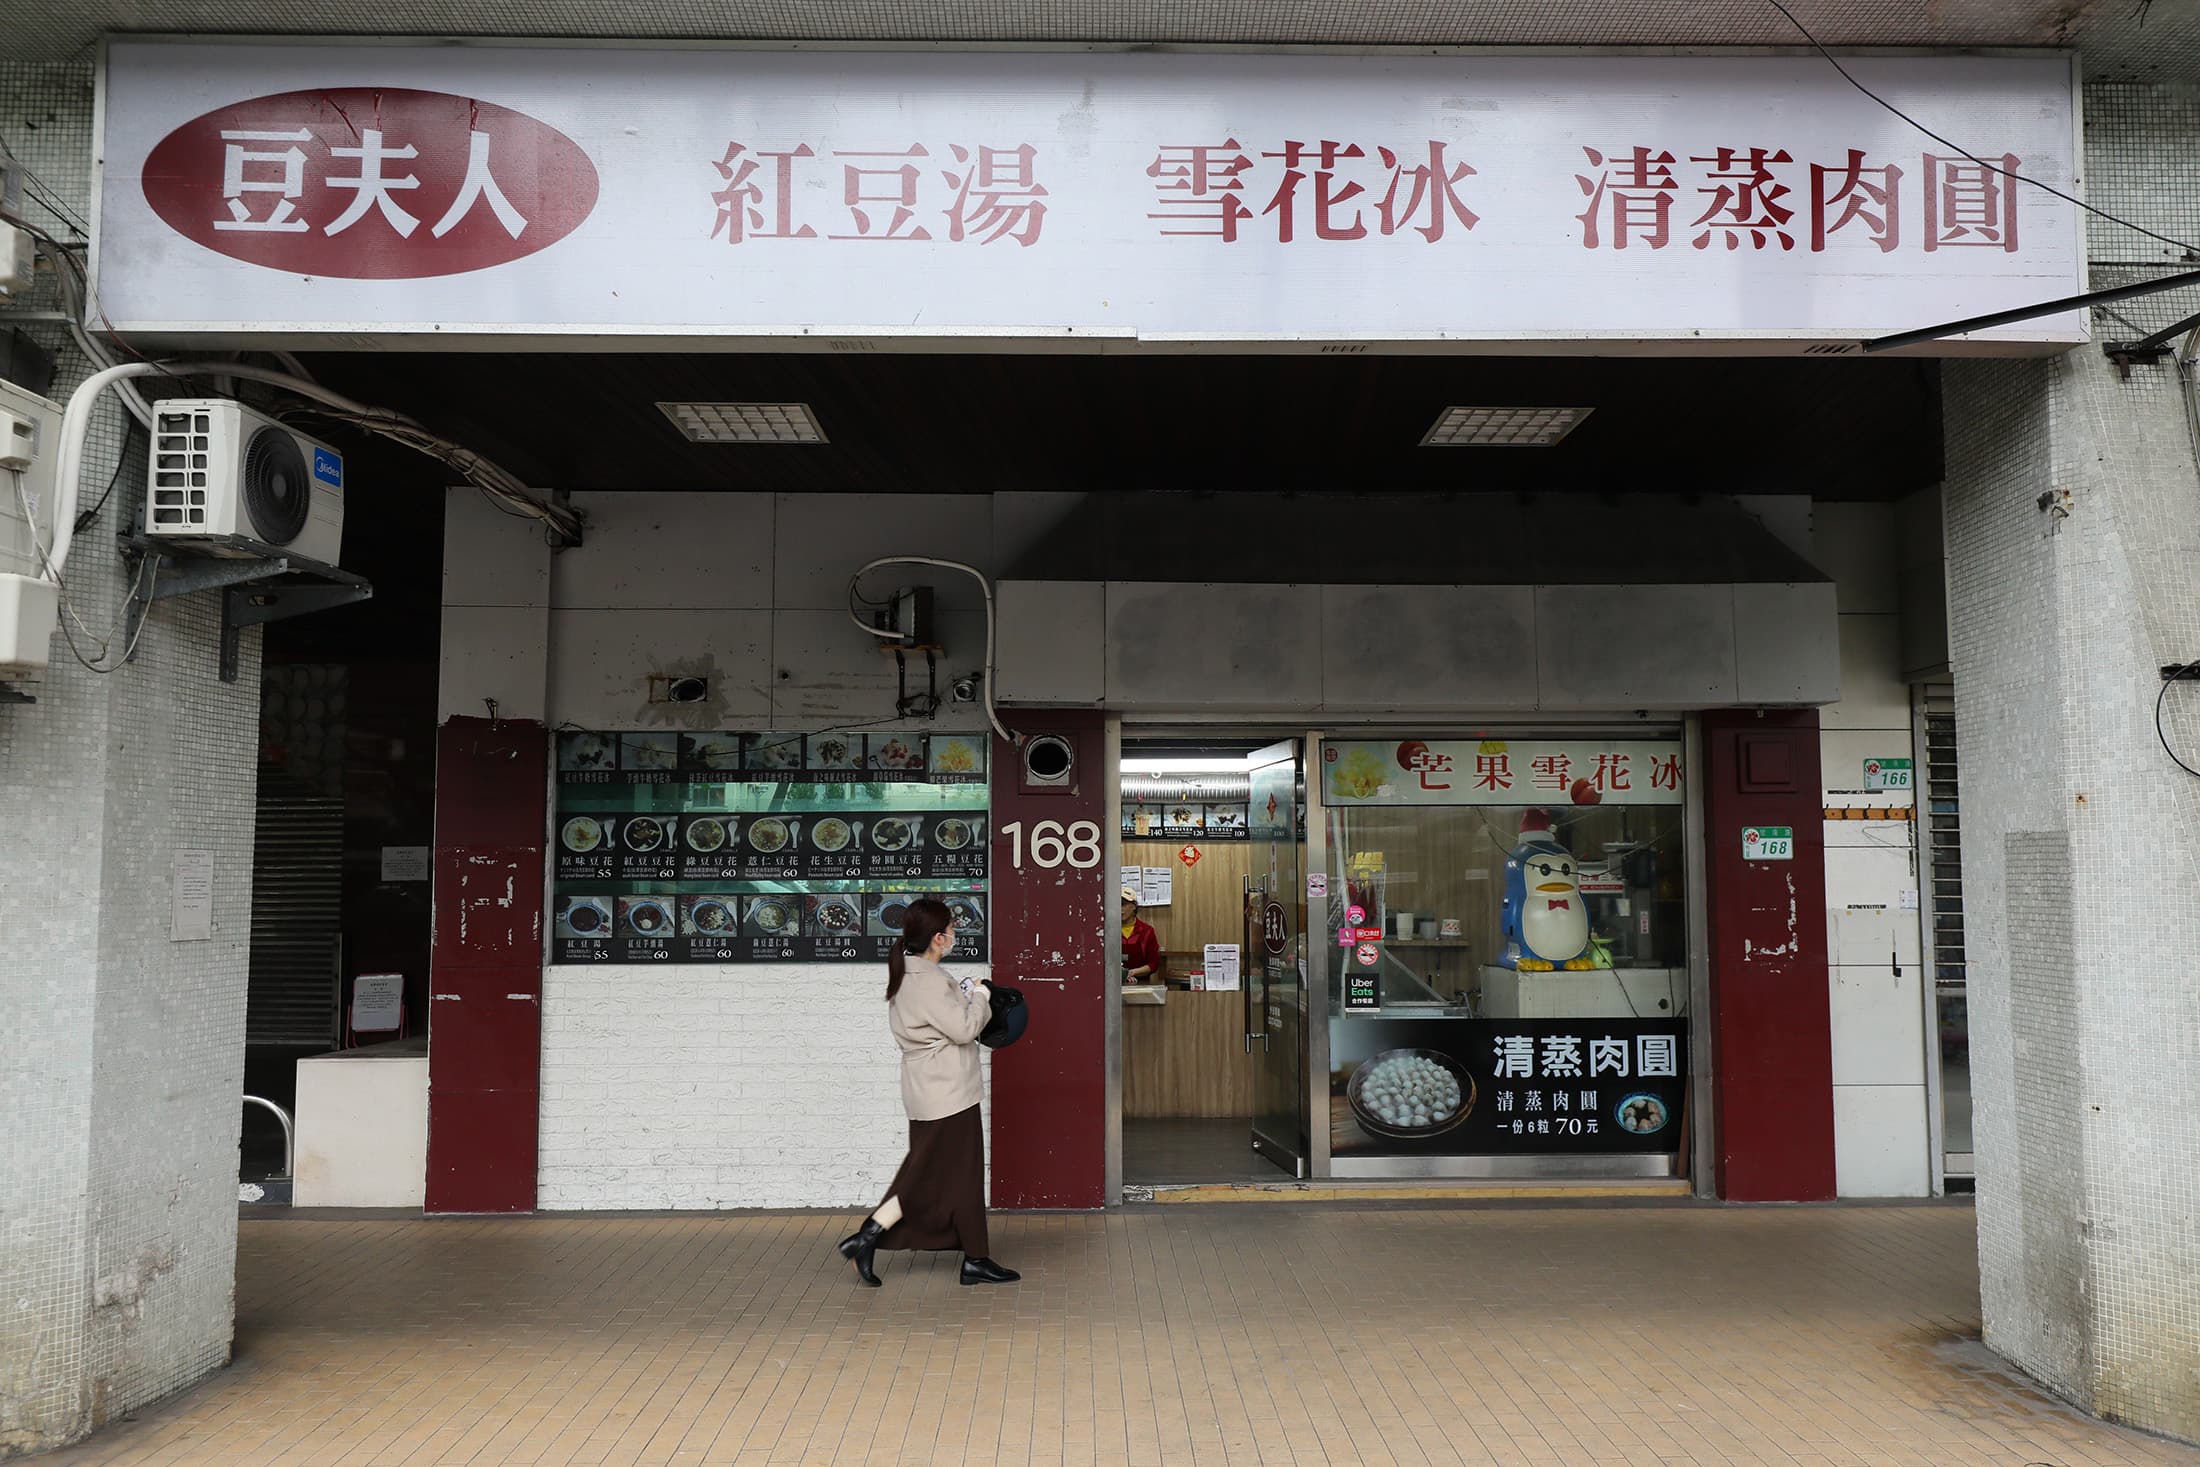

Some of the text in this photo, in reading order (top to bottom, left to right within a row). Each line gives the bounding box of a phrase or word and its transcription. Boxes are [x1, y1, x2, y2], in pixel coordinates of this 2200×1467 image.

[211, 127, 530, 241] 豆夫人
[710, 139, 2020, 253] 紅豆湯 雪花冰 清蒸肉圓
[317, 457, 340, 478] Midea
[1411, 753, 1682, 792] 芒果雪花冰
[1882, 772, 1908, 786] 166
[1001, 820, 1102, 869] 168
[1760, 841, 1788, 855] 168
[561, 855, 613, 866] 原味豆花
[623, 855, 675, 866] 紅豆豆花
[684, 855, 737, 866] 綠豆豆花
[811, 855, 861, 866] 花生豆花
[597, 868, 612, 878] 55
[659, 868, 675, 878] 60
[721, 868, 736, 878] 60
[783, 868, 798, 877] 60
[846, 867, 861, 877] 60
[906, 867, 921, 876] 60
[968, 868, 983, 877] 70
[594, 950, 609, 960] 55
[653, 950, 669, 960] 60
[717, 949, 732, 959] 60
[781, 948, 793, 958] 60
[842, 948, 856, 958] 60
[963, 947, 978, 956] 70
[1351, 979, 1373, 988] Uber
[1351, 988, 1374, 996] Eats
[1493, 1034, 1677, 1079] 清蒸肉圓
[1497, 1090, 1597, 1111] 清蒸肉圓
